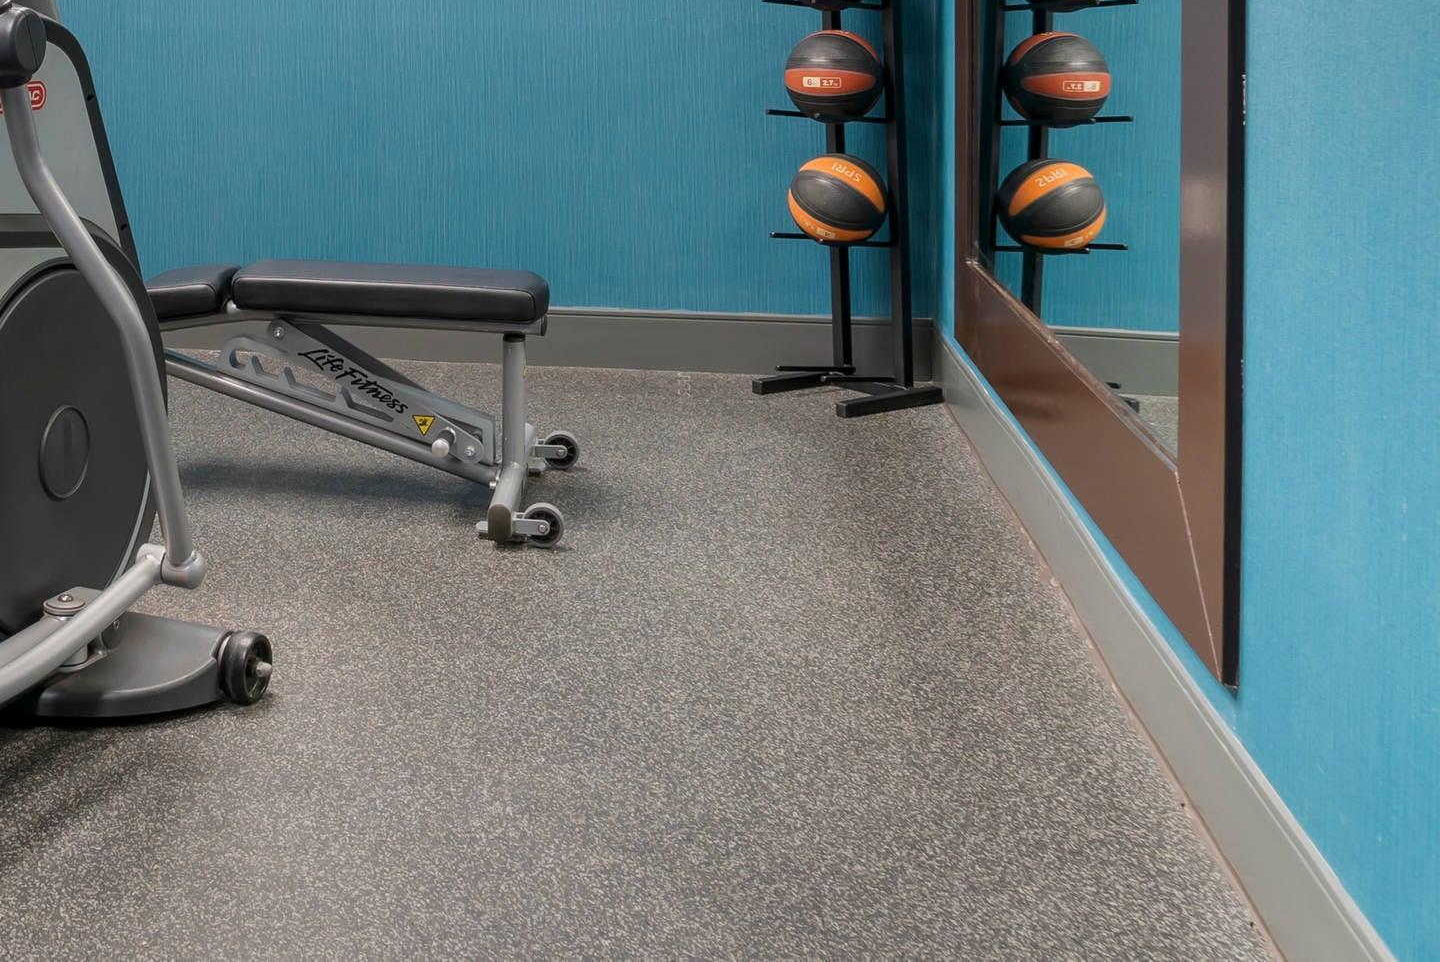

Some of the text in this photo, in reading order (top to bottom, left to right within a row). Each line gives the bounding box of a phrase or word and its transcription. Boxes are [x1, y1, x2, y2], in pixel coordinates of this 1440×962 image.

[831, 161, 862, 182] SPRI
[298, 349, 409, 414] Life Fitness
